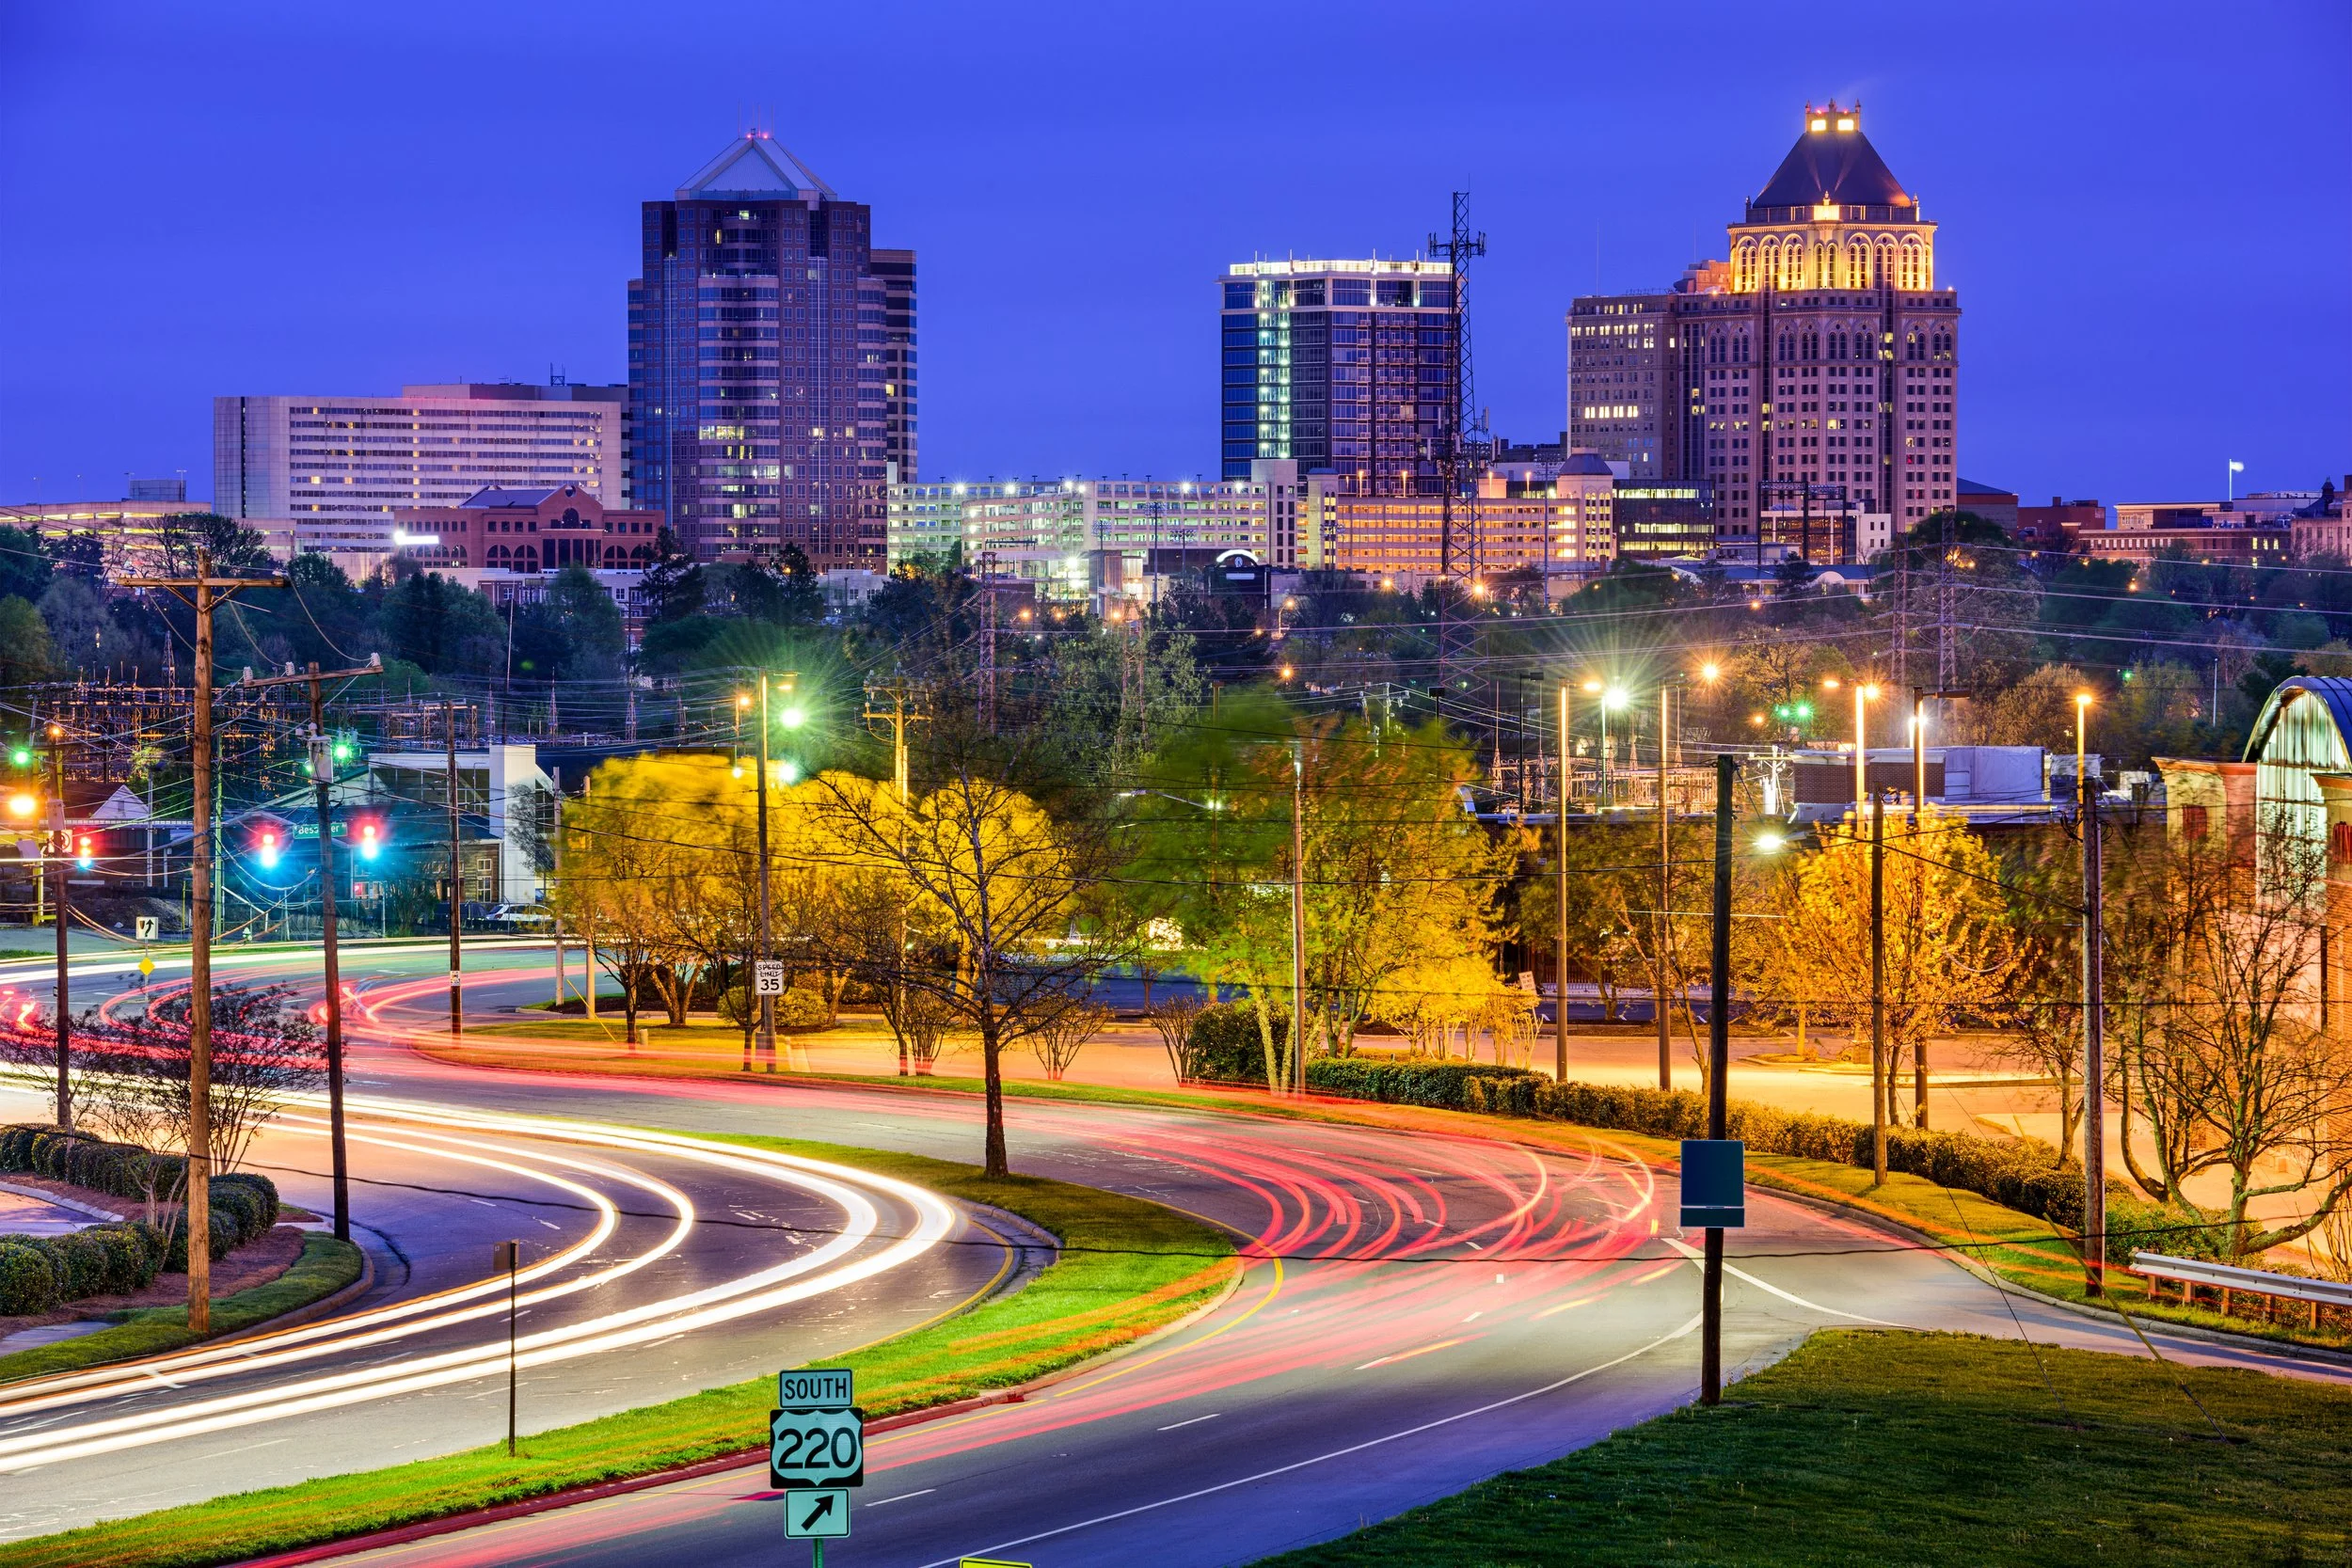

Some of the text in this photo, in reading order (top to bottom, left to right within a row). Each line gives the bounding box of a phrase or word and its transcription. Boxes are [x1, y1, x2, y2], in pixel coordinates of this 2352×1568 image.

[298, 825, 340, 834] Besser
[760, 978, 780, 990] 35
[784, 1377, 847, 1400] SOUTH
[777, 1427, 857, 1469] 220
